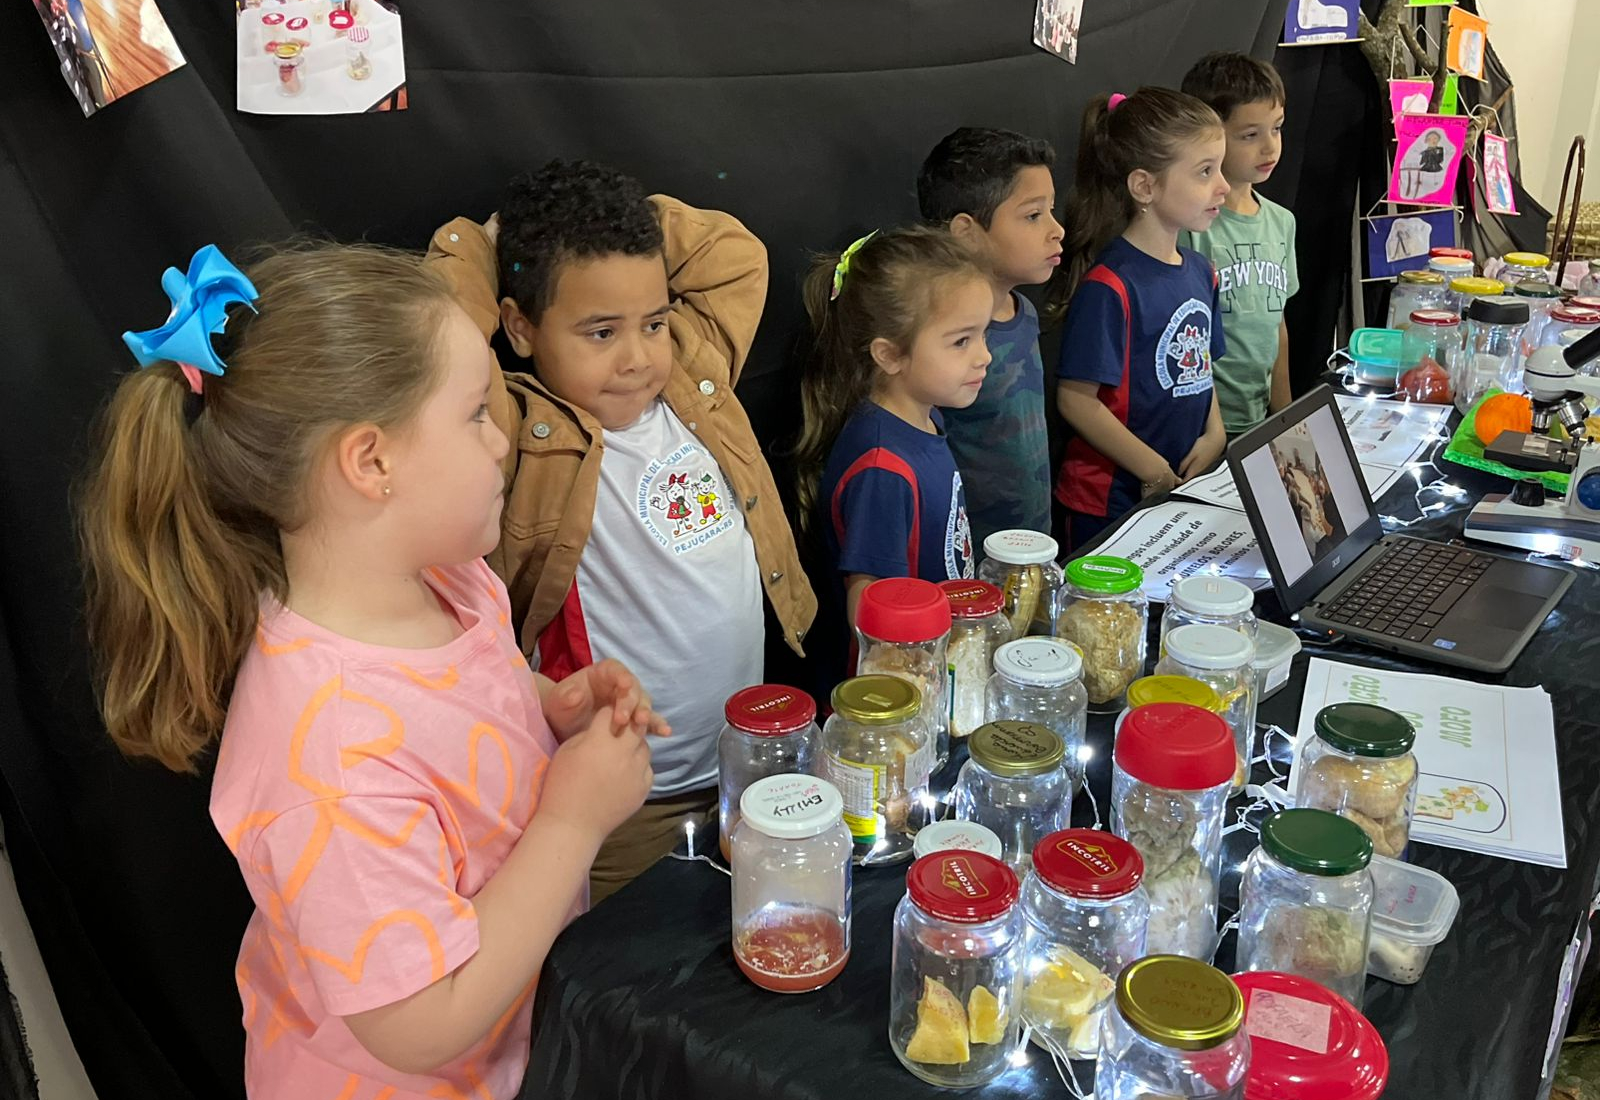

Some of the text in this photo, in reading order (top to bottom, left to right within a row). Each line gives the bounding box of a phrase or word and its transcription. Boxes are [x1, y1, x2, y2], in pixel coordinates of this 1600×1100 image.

[1215, 261, 1251, 293] EW
[1156, 324, 1176, 361] MUNICIPAL
[648, 462, 661, 475] DE
[638, 472, 654, 519] MUNICIPAL
[644, 519, 668, 547] ESCOLA
[945, 512, 956, 556] MUNICIPAL
[1140, 522, 1174, 549] incluem
[1170, 510, 1189, 524] uma
[1157, 528, 1193, 557] variedade
[1190, 519, 1203, 530] de
[1157, 531, 1218, 576] organismos como
[1165, 529, 1248, 588] COUMELOS, BOLORES,
[749, 693, 793, 712] INCOTRIL
[1439, 705, 1472, 749] MOFO
[1066, 841, 1112, 873] INCOTRIL
[949, 860, 978, 897] INCOTRIL
